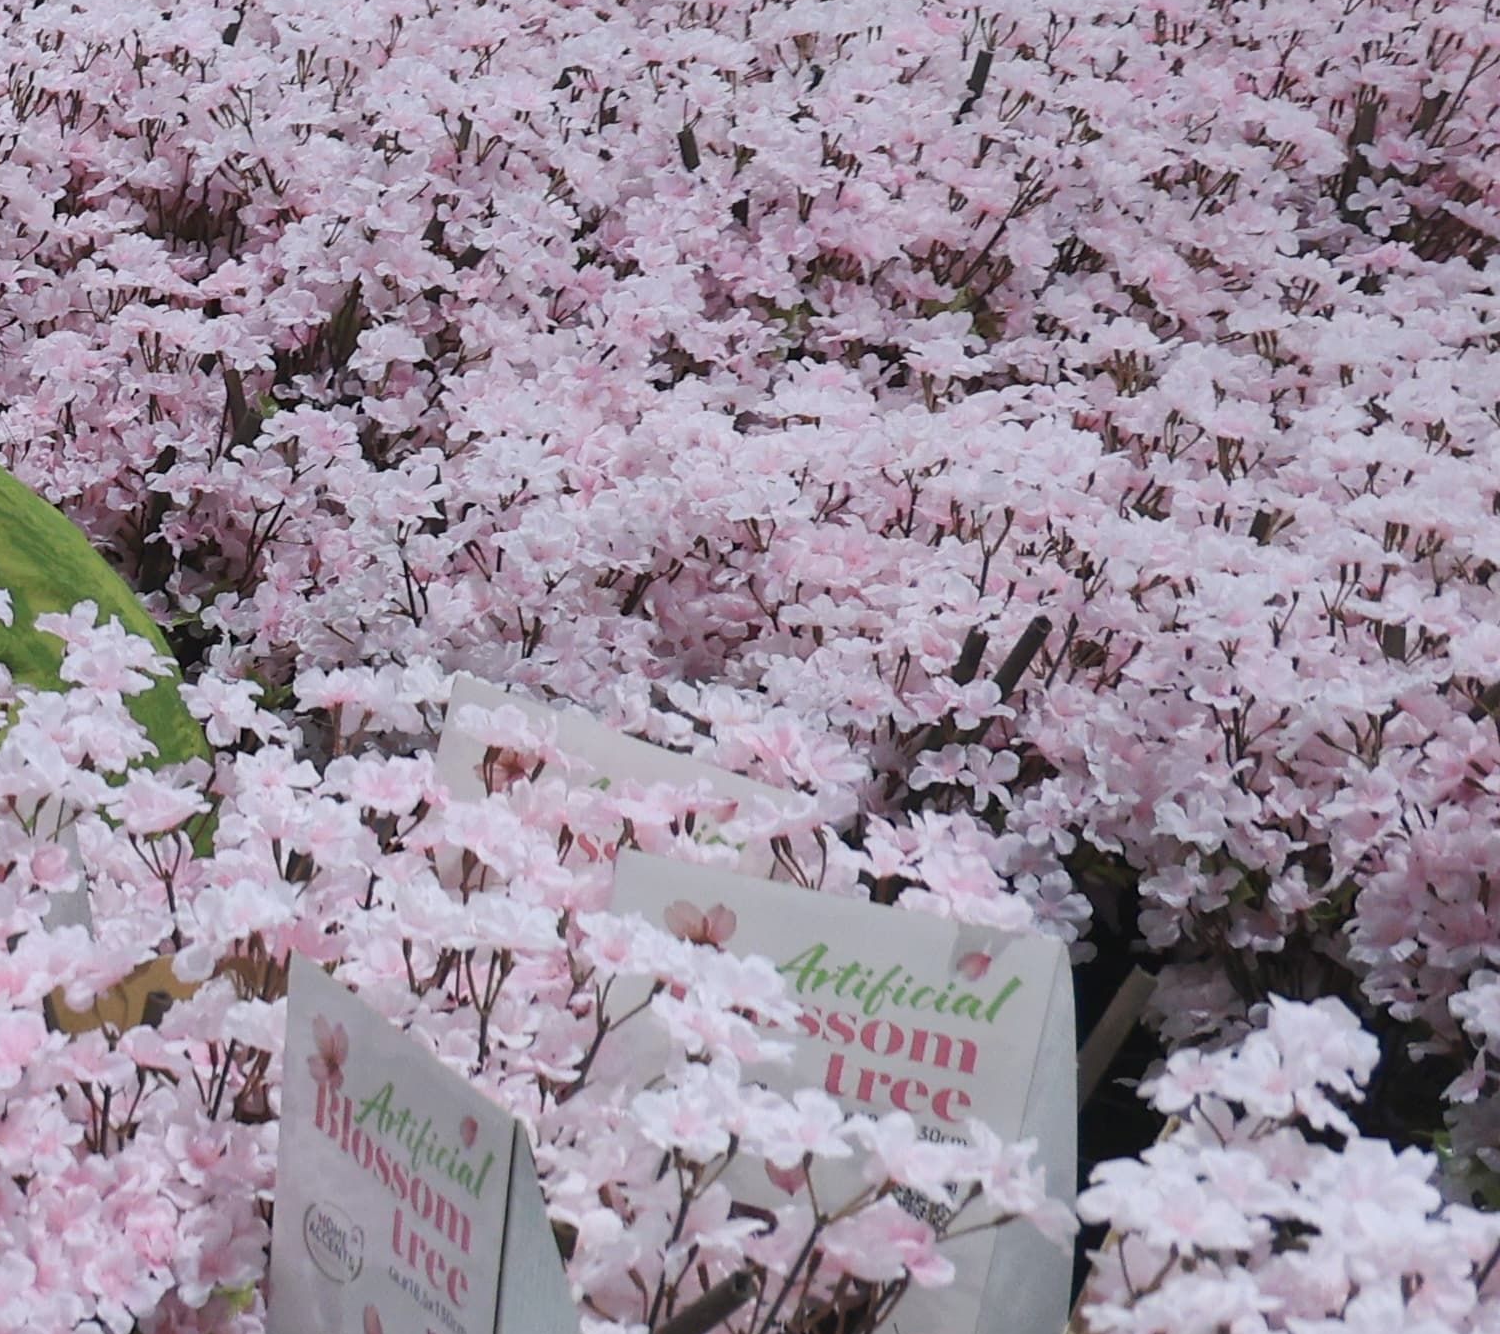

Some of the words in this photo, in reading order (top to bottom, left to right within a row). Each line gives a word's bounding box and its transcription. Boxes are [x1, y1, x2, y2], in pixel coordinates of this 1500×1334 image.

[780, 941, 1023, 1025] Artificial
[823, 1051, 972, 1125] tree
[313, 1082, 473, 1255] Blossom
[354, 1082, 495, 1199] Artificial
[392, 1207, 469, 1308] tree
